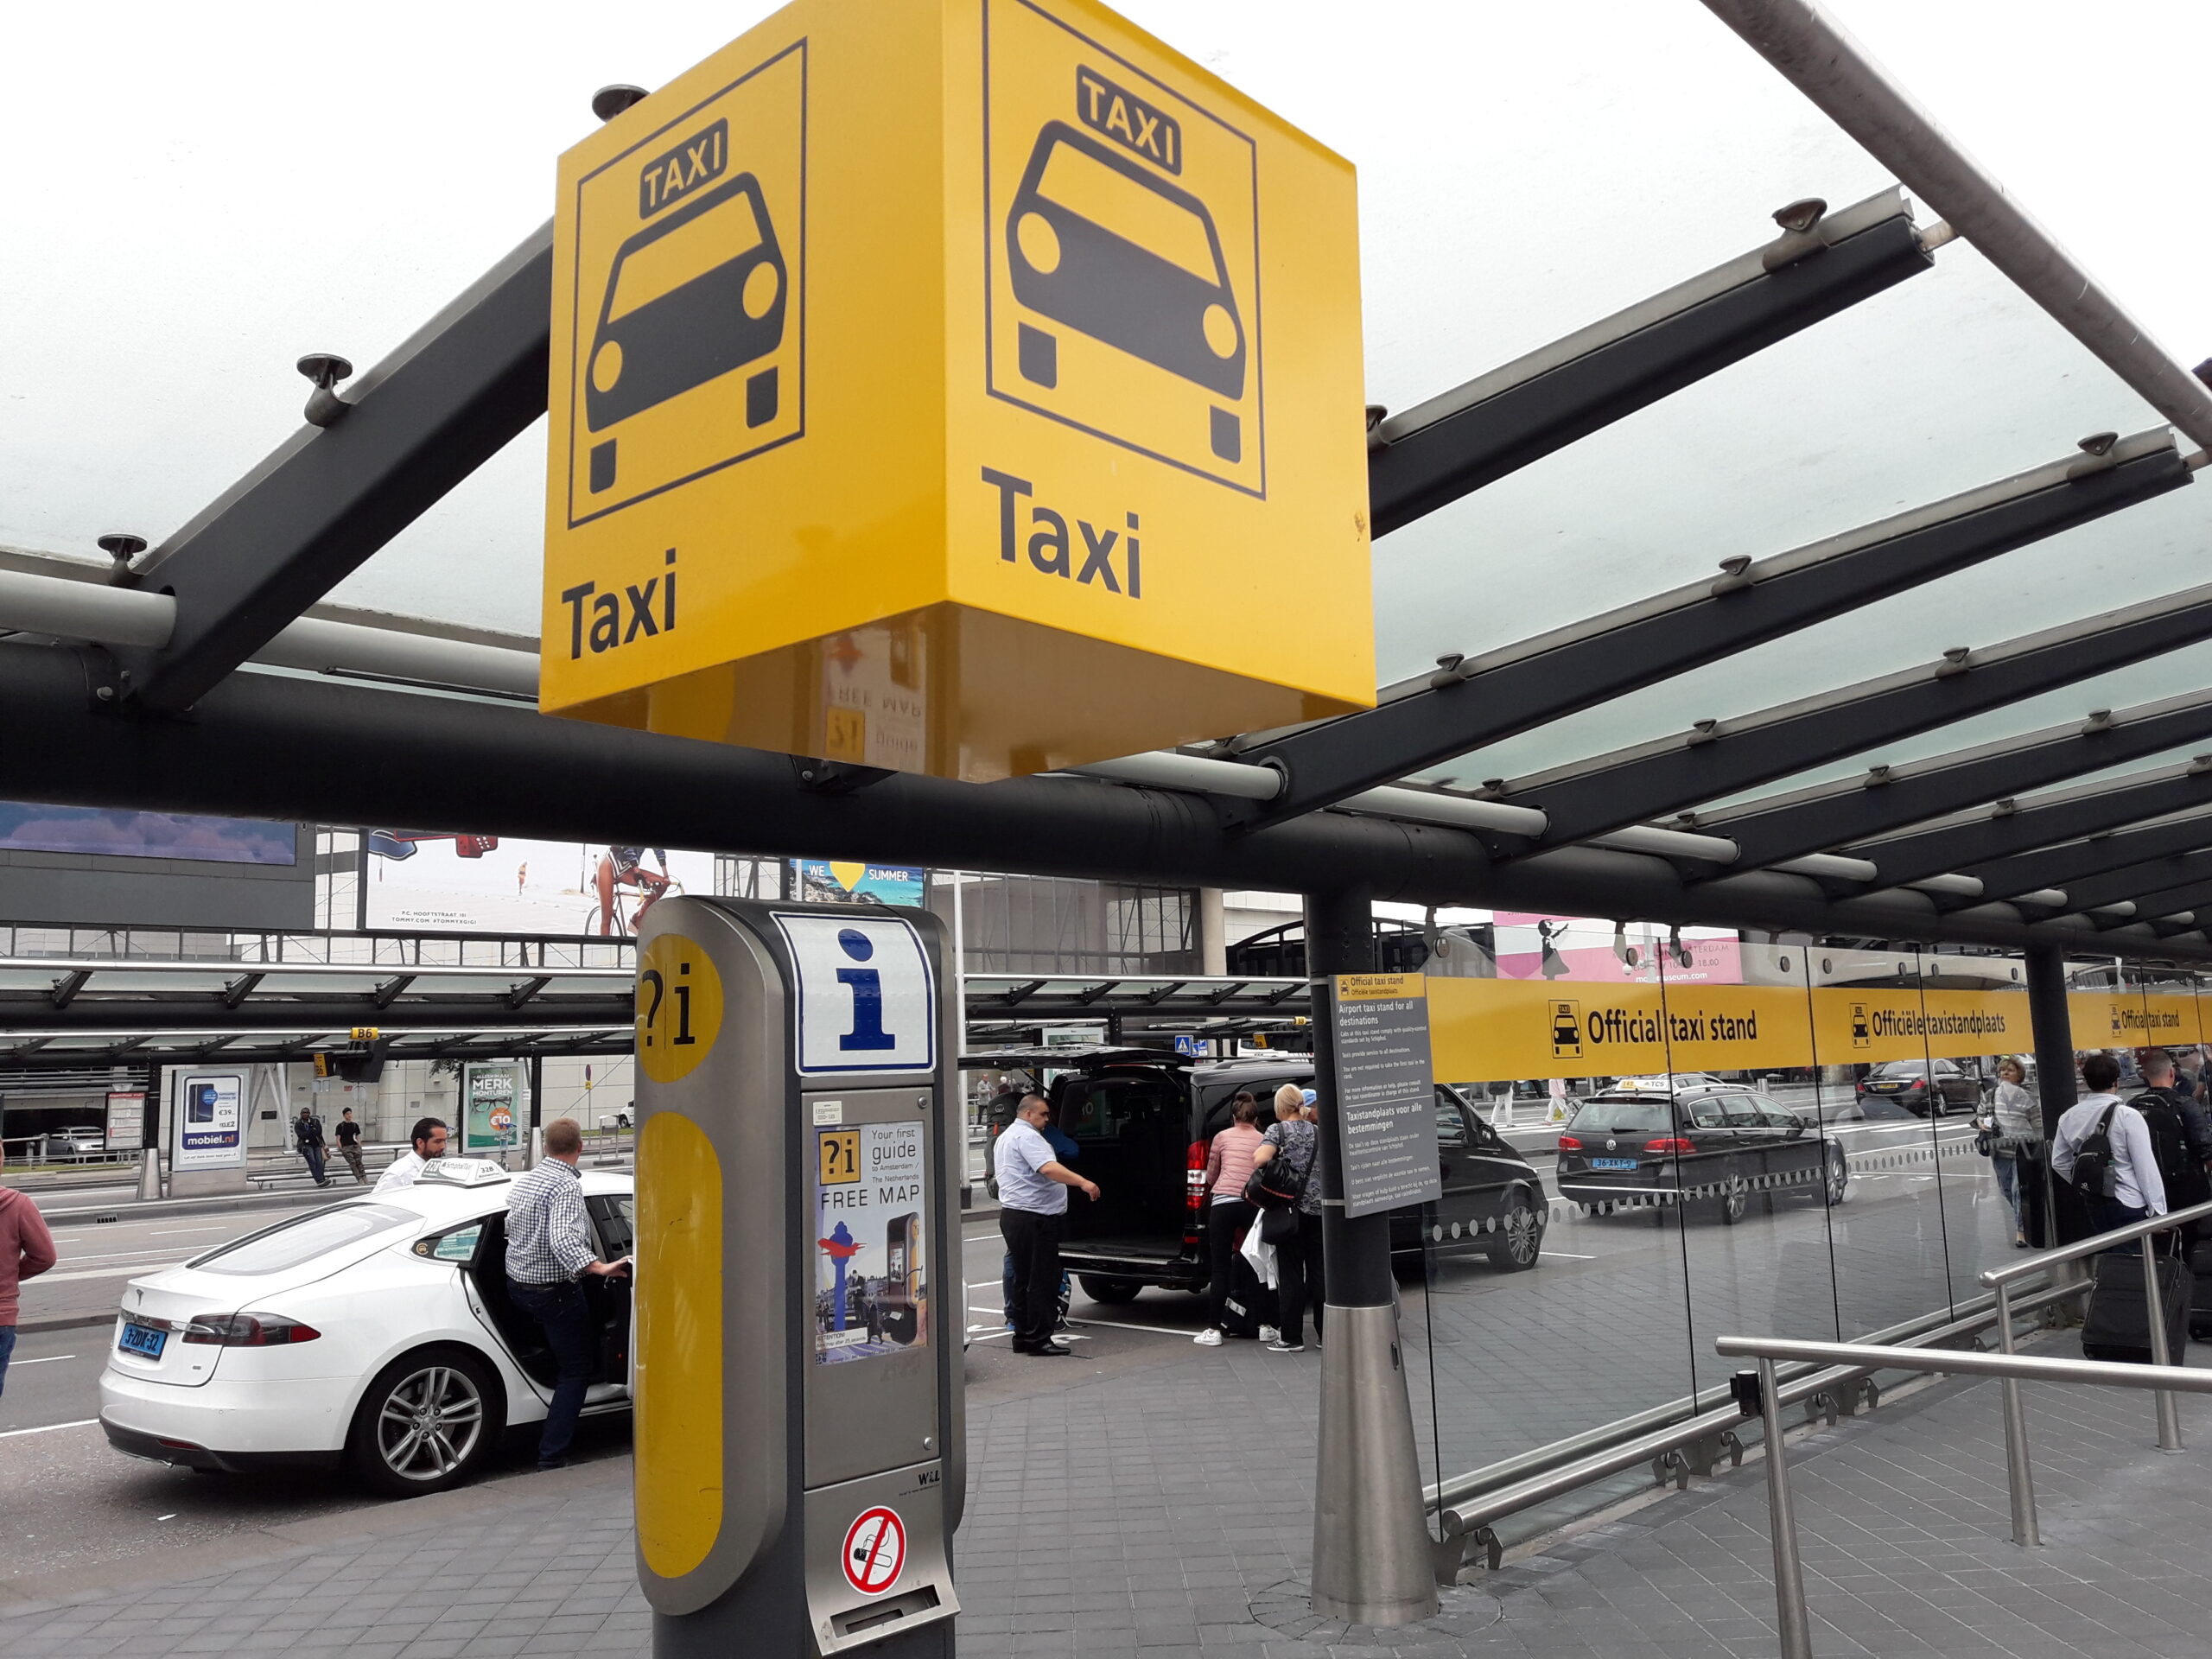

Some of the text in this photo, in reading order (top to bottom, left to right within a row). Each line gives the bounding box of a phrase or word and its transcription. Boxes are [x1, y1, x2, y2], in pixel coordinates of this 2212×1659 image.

[1081, 76, 1175, 166] TAXI
[644, 130, 722, 210] TAXI
[982, 465, 1141, 600] Taxi
[562, 547, 677, 661] Taxi
[809, 865, 909, 881] WE SUMMER
[1351, 975, 1404, 986] Official taxi stand
[1339, 1004, 1363, 1015] Airport
[1363, 1002, 1376, 1012] taxi
[1376, 1001, 1394, 1012] stand
[1395, 1001, 1405, 1010] for
[1339, 1016, 1378, 1027] destinations
[1588, 1008, 1758, 1044] Official taxi stand
[1872, 1009, 2005, 1039] Officiële taxistandplaats
[2121, 1008, 2180, 1029] Official taxi stand
[358, 1028, 372, 1039] B6
[473, 1078, 512, 1090] MERK
[491, 1116, 511, 1126] €10
[1346, 1103, 1422, 1122] Taxistandplaats voor alle
[872, 1128, 915, 1140] Your first
[1348, 1120, 1394, 1134] bestemmingen
[188, 1135, 234, 1146] mobiel.nl
[873, 1141, 916, 1165] guide
[821, 1185, 919, 1210] FREE MAP
